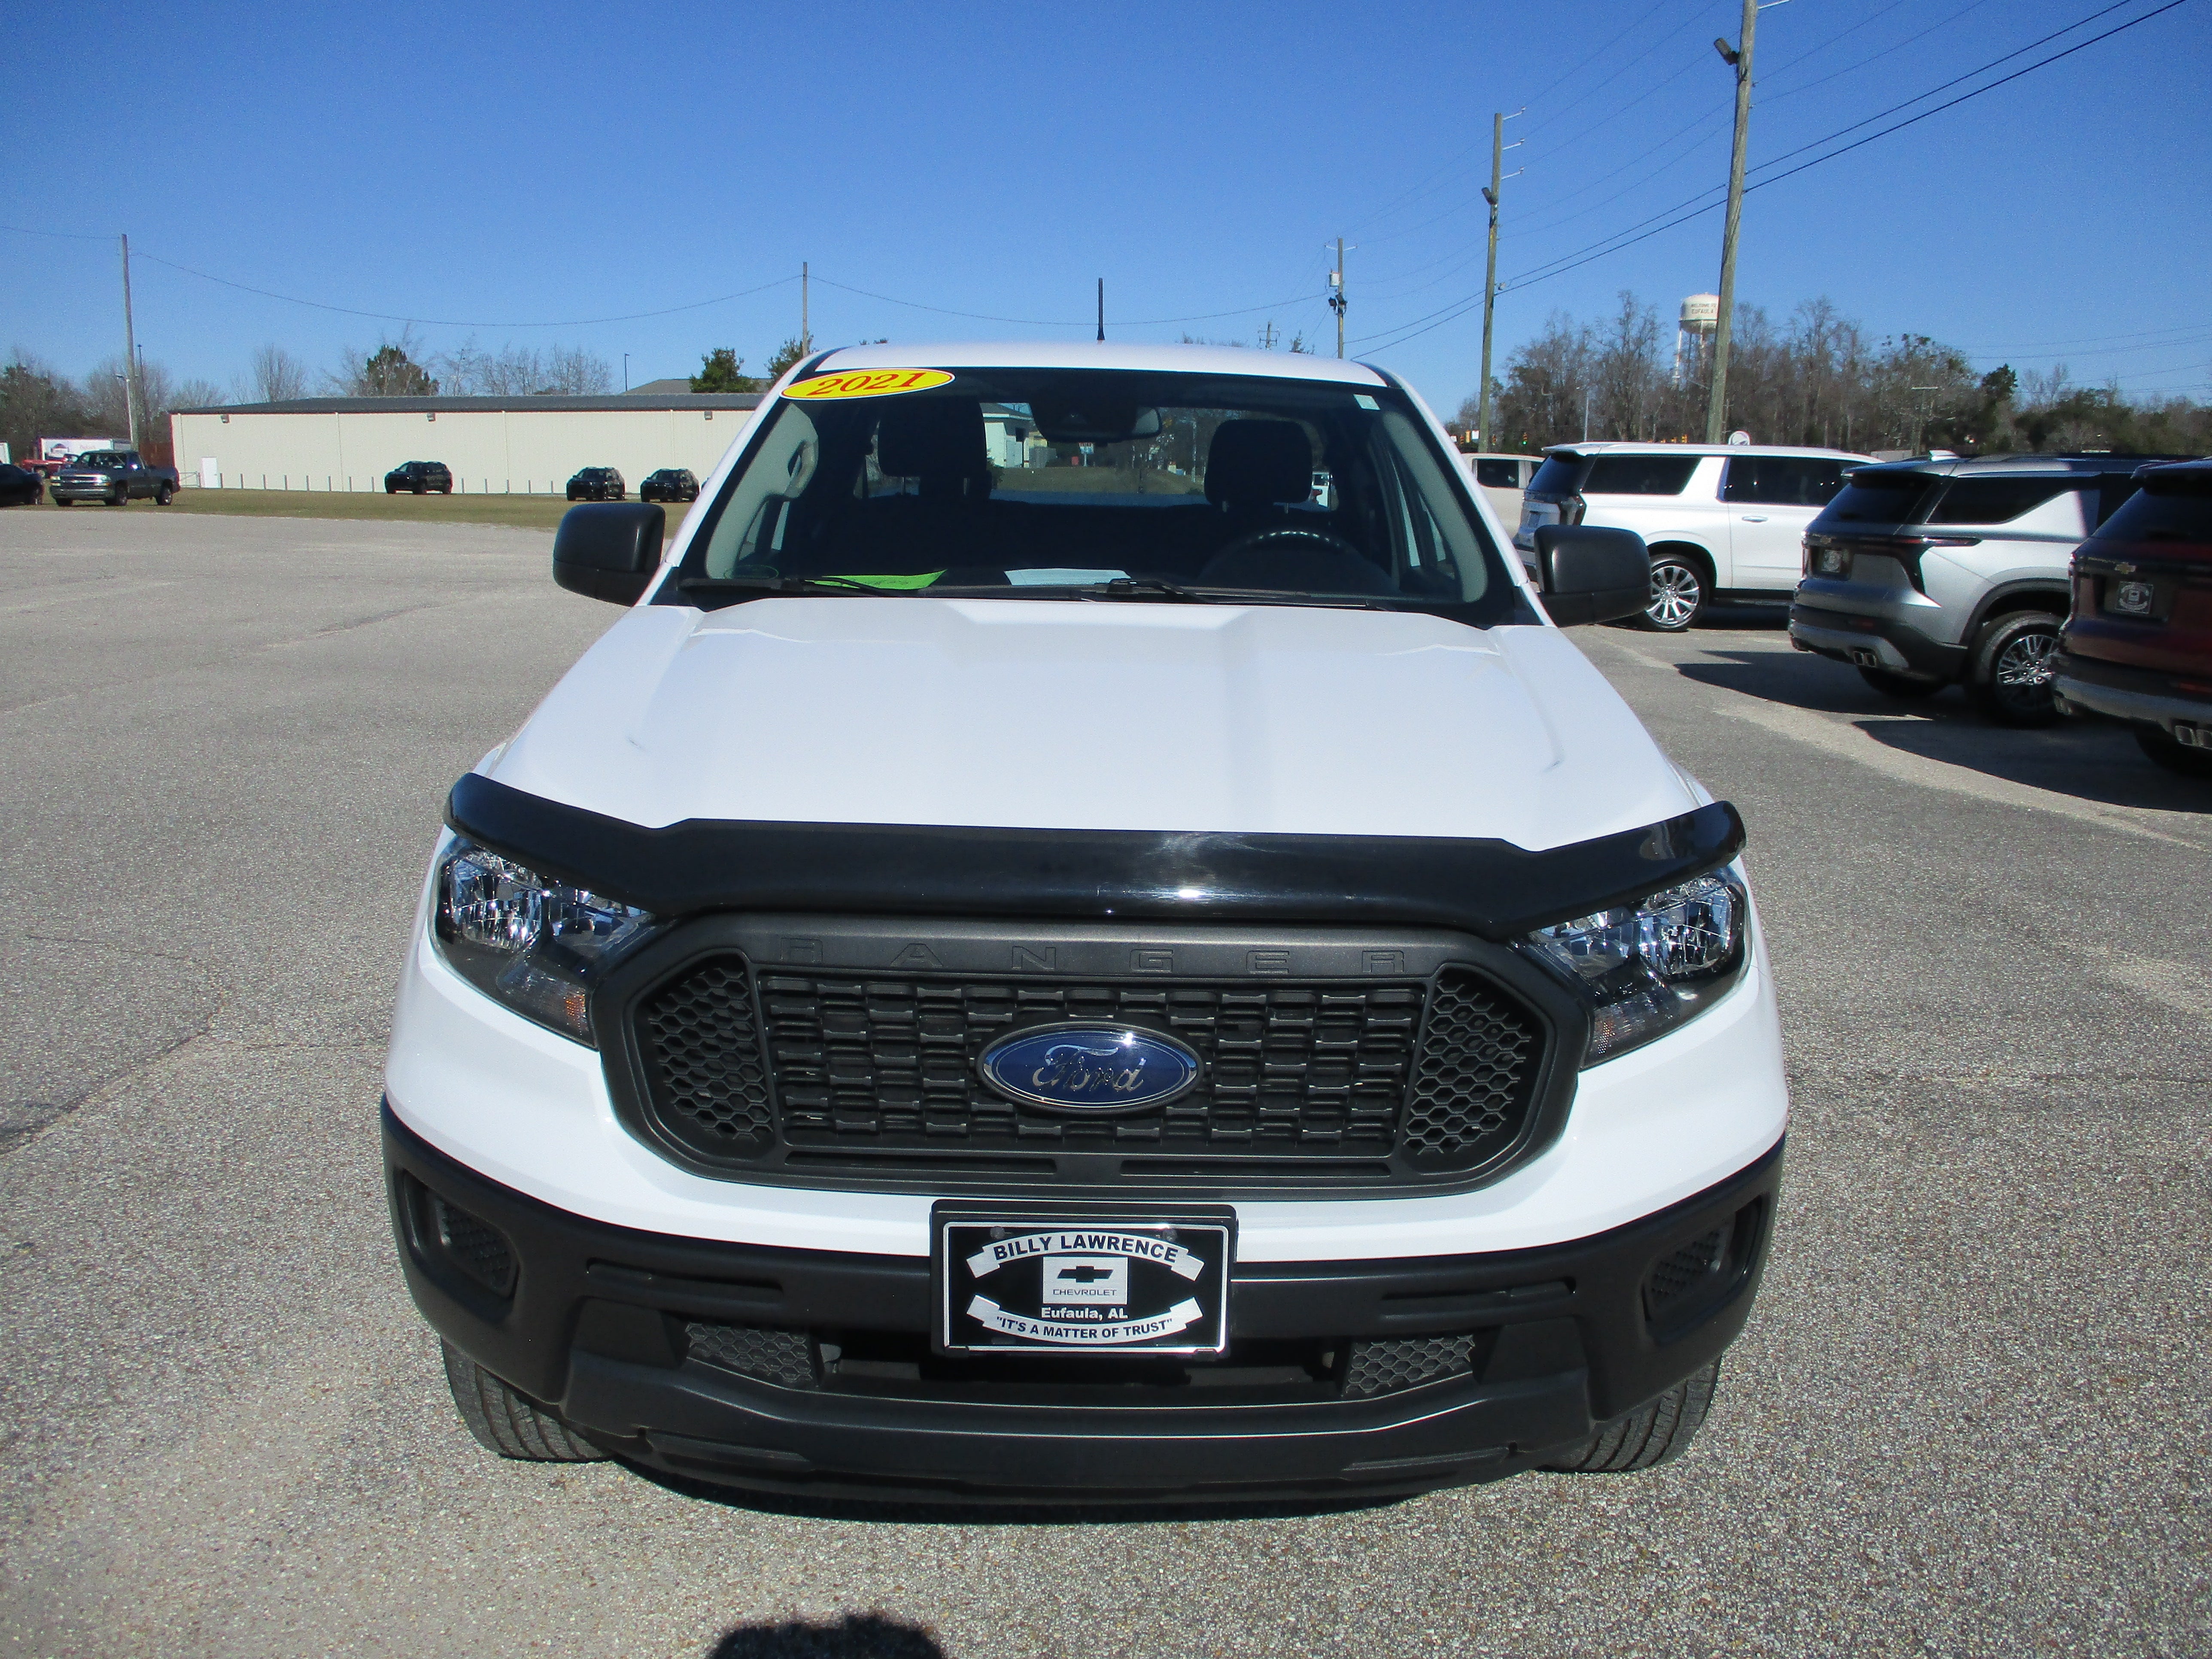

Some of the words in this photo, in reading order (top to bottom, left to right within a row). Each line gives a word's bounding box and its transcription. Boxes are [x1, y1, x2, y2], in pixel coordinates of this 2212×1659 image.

[806, 372, 927, 396] 2021
[780, 938, 1405, 973] RANGER
[1032, 1044, 1147, 1092] Ford
[994, 1236, 1052, 1261] BILLY
[1060, 1235, 1179, 1263] LAWRENCE
[997, 1316, 1026, 1331] "IT'S
[1030, 1325, 1039, 1334] A
[1043, 1328, 1097, 1338] MATTER
[1102, 1328, 1119, 1338] OF
[1124, 1318, 1173, 1335] TRUST"
[1041, 1307, 1103, 1321] Eufaula,
[1107, 1307, 1128, 1319] AL
